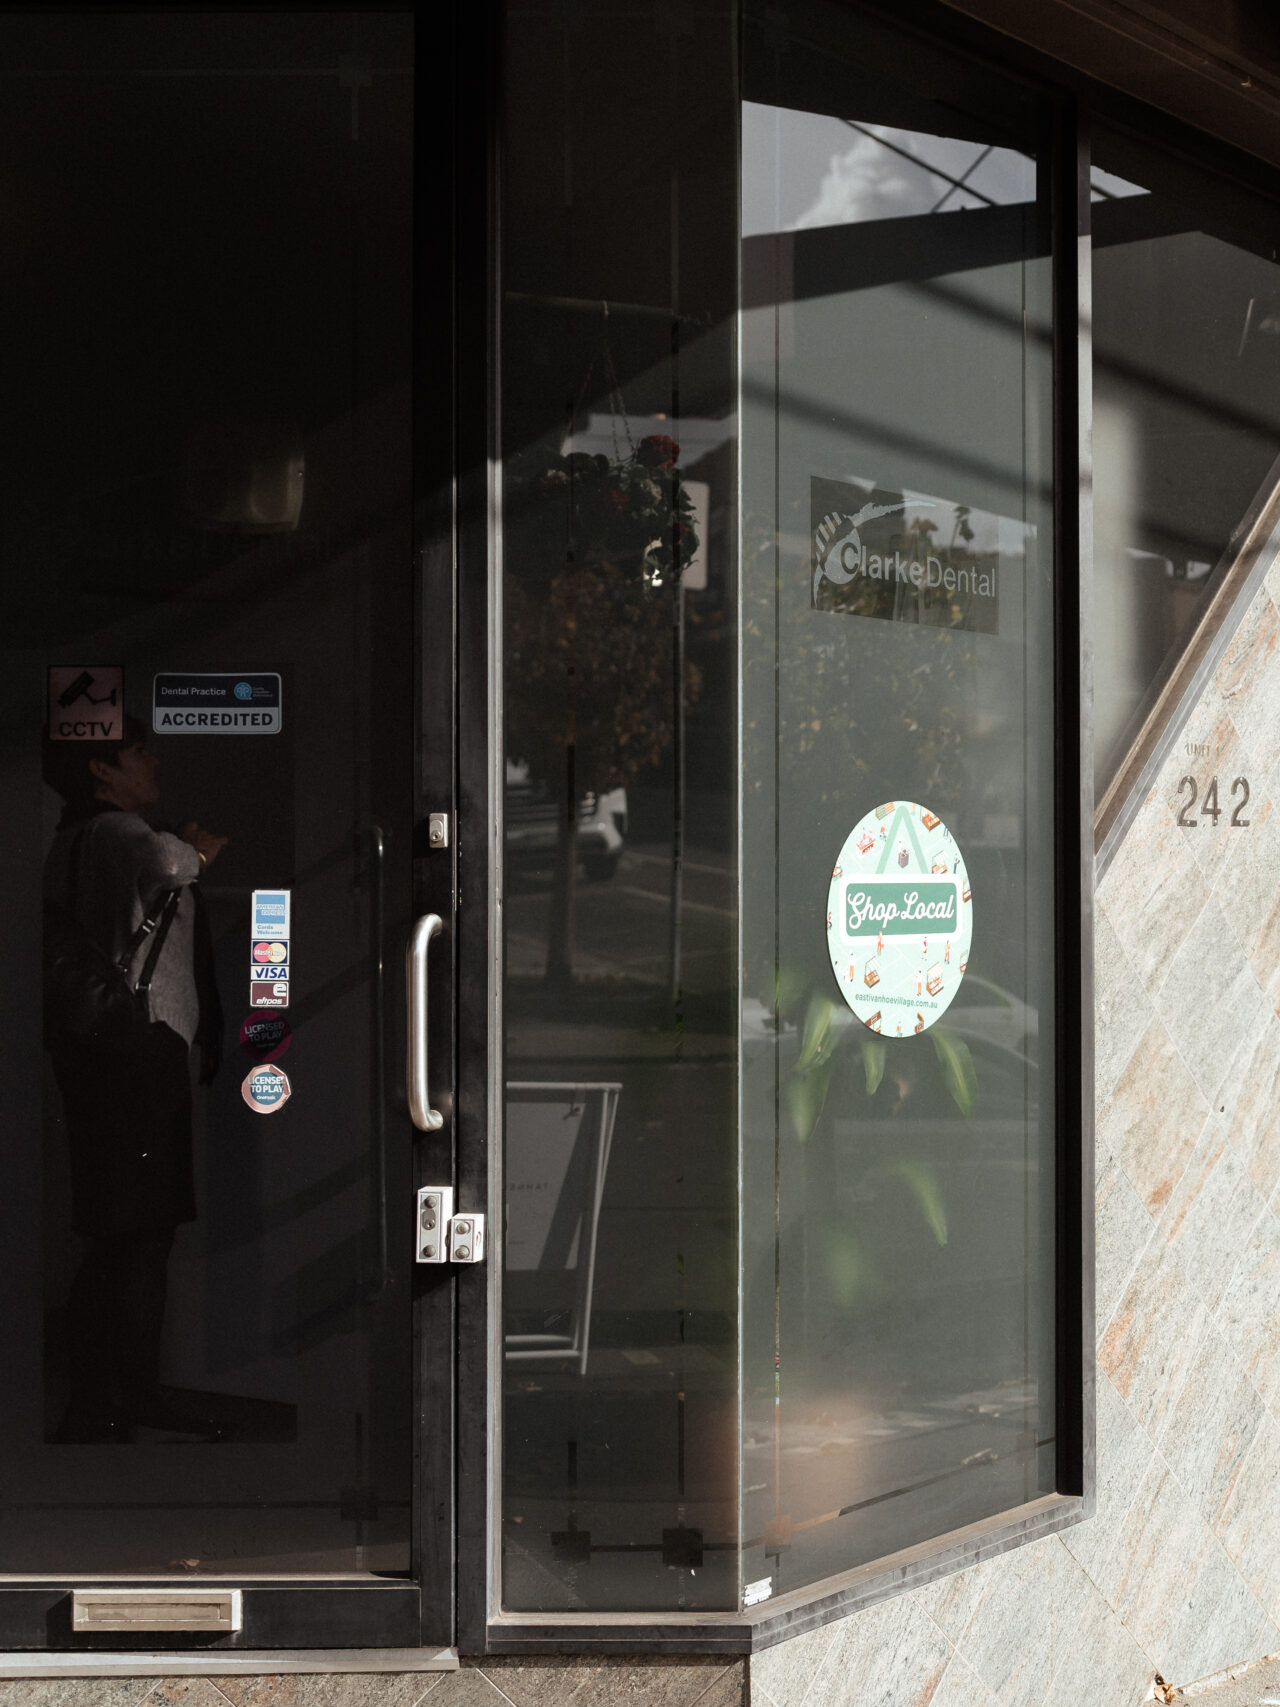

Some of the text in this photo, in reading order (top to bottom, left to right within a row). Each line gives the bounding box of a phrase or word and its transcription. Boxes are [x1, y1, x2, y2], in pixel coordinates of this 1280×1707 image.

[161, 686, 227, 696] Dental Practice
[162, 713, 273, 726] ACCREDITED
[58, 721, 113, 737] CCTV
[1185, 742, 1211, 757] UNIT
[1177, 775, 1250, 827] 242
[847, 891, 954, 929] Shop Local
[255, 967, 287, 979] VISA
[256, 996, 283, 1005] eftpos
[855, 993, 938, 1009] eastivanhoevillage.com.au
[244, 1021, 285, 1034] LICENSED
[249, 1031, 282, 1042] TO PLAY
[251, 1084, 284, 1093] TO PLAY
